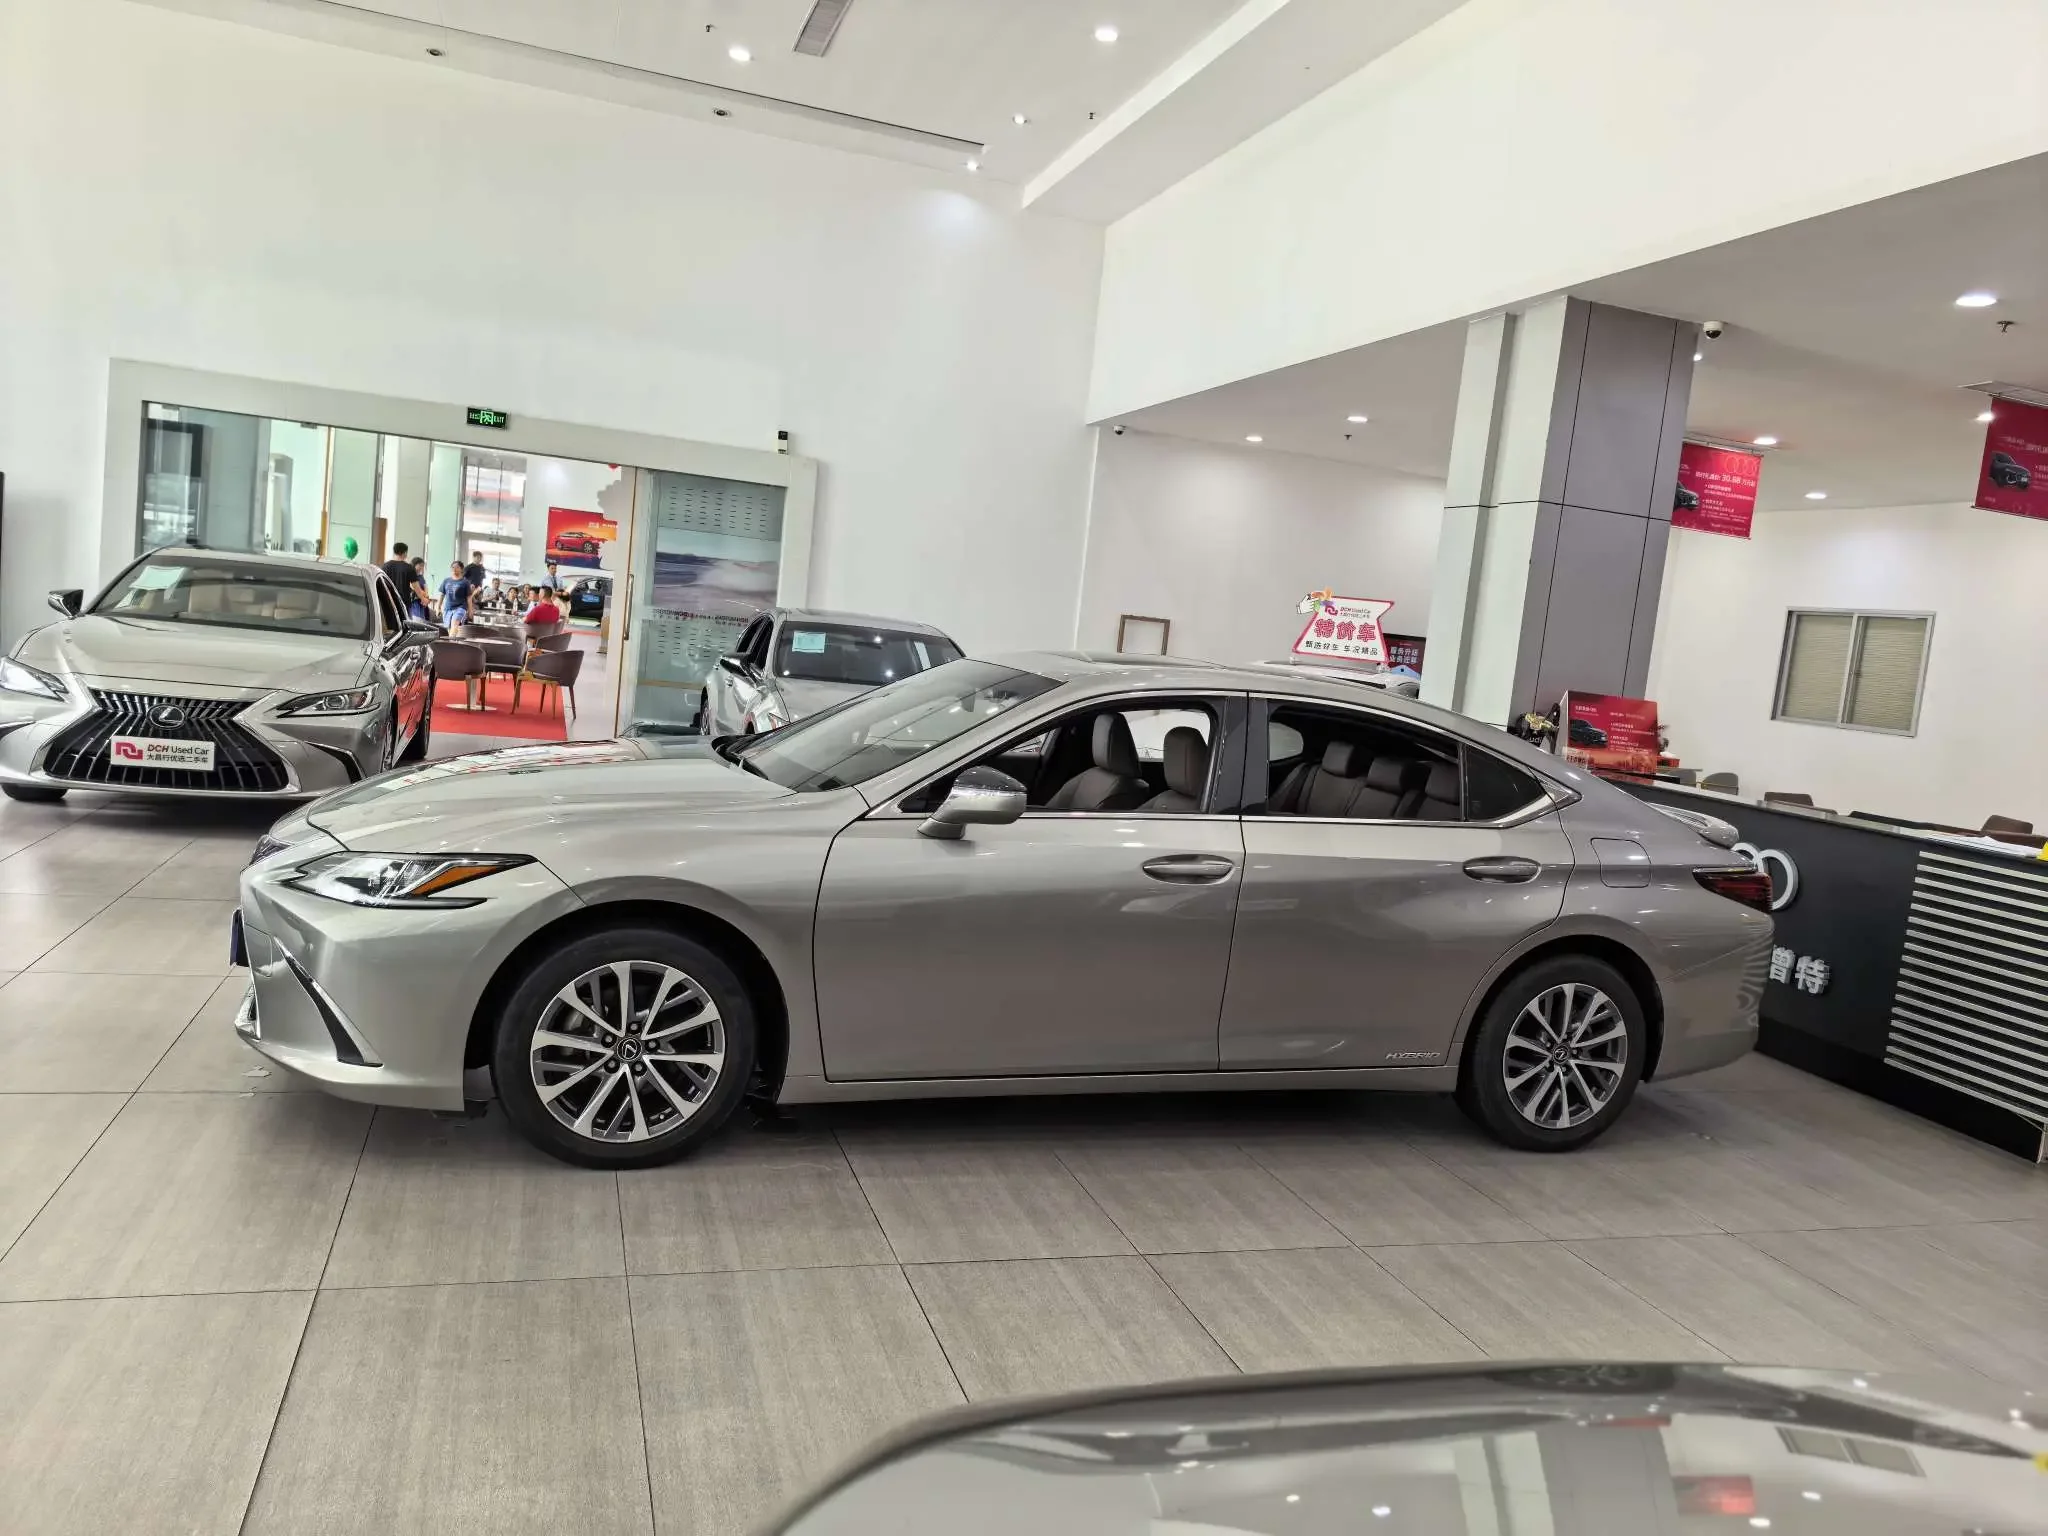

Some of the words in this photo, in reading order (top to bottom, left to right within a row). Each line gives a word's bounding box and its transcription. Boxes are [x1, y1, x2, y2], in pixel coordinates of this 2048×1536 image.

[1314, 619, 1376, 642] 特价车
[147, 744, 169, 753] DCH
[171, 745, 193, 754] Used
[194, 747, 209, 755] Car
[1385, 1052, 1441, 1060] HYBRID
